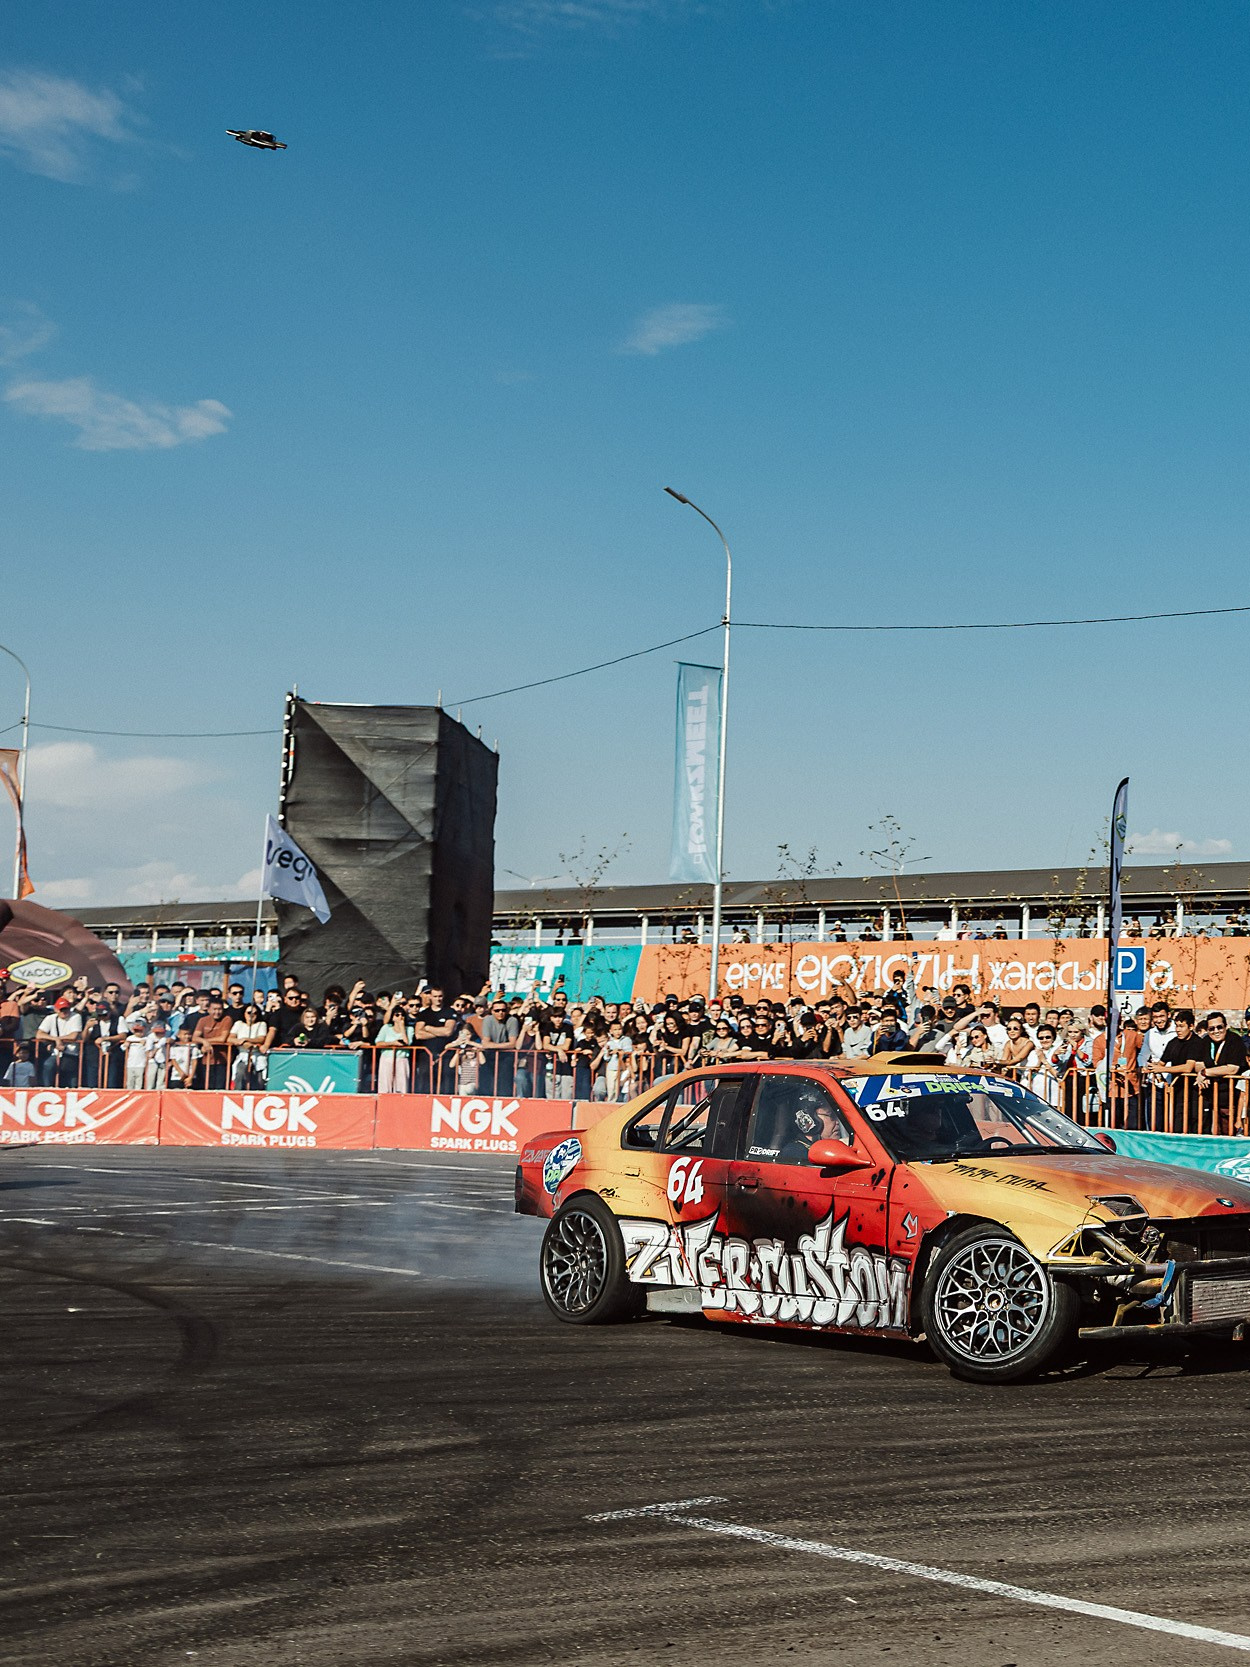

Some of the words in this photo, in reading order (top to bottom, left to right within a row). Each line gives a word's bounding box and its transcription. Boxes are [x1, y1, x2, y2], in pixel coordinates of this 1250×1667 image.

[18, 967, 62, 978] YACCO
[1117, 951, 1138, 986] P
[0, 1091, 99, 1127] NGK
[221, 1095, 320, 1132] NGK
[431, 1098, 520, 1136] NGK
[865, 1102, 906, 1121] 64
[0, 1130, 42, 1142] PARK
[221, 1133, 266, 1146] SPARK
[269, 1134, 317, 1148] PLUGS
[430, 1136, 472, 1149] SPARK
[474, 1138, 518, 1152] PLUGS
[667, 1156, 704, 1205] 64
